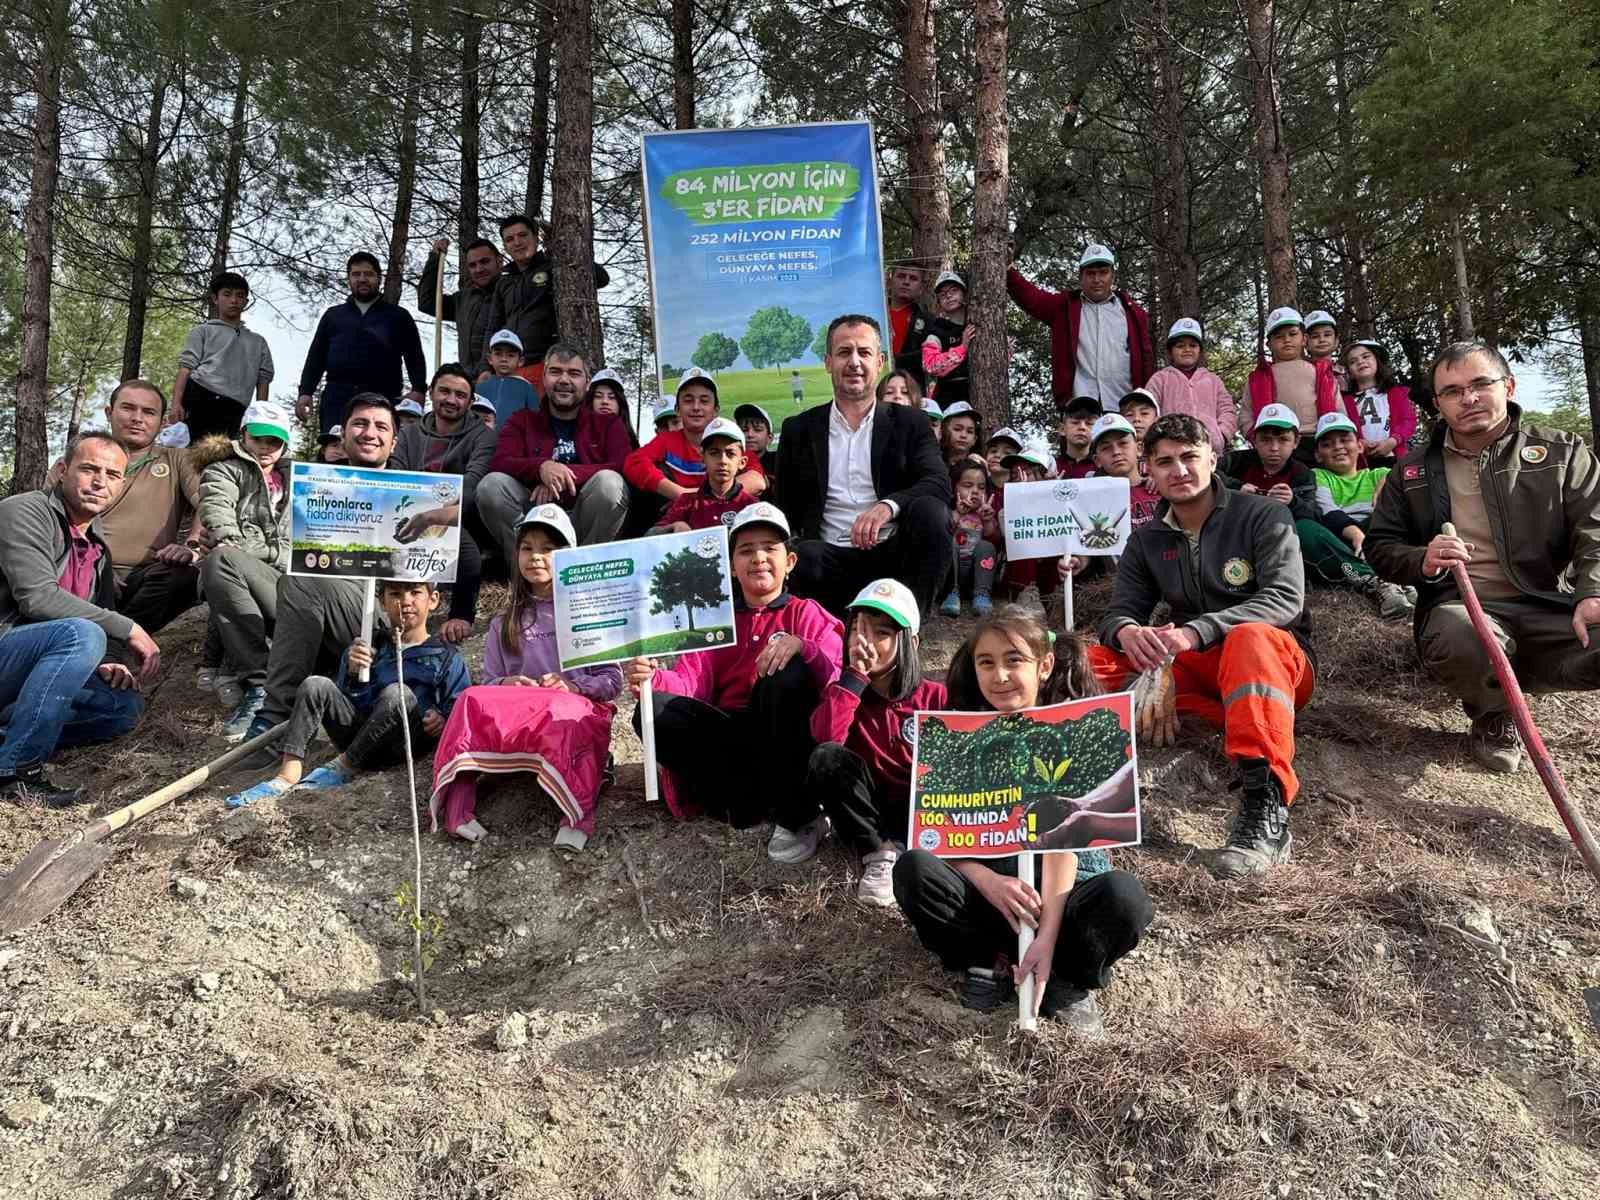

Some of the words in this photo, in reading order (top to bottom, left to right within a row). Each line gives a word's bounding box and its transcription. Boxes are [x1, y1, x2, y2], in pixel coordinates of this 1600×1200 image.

[675, 178, 705, 195] 84
[712, 169, 796, 194] MİLYON
[804, 163, 847, 191] İÇİN
[702, 198, 752, 219] 3'ER
[757, 191, 824, 217] FİDAN
[690, 233, 720, 246] 252
[723, 229, 786, 244] MİLYON
[790, 225, 842, 241] FİDAN
[717, 250, 777, 263] GELECEĞE
[306, 495, 374, 512] milyonlarca
[307, 507, 335, 521] fidan
[336, 508, 384, 525] dikiyoruz
[1008, 516, 1034, 529] "BİR
[1037, 514, 1073, 527] FİDAN
[1013, 528, 1034, 540] BİN
[1037, 526, 1080, 538] HAYAT"
[406, 549, 448, 577] nefes
[568, 562, 604, 575] GELECEĞE
[921, 784, 1023, 809] CUMHURİYETİN
[919, 810, 949, 826] 100.
[952, 808, 1009, 826] YILINDA
[947, 832, 975, 847] 100
